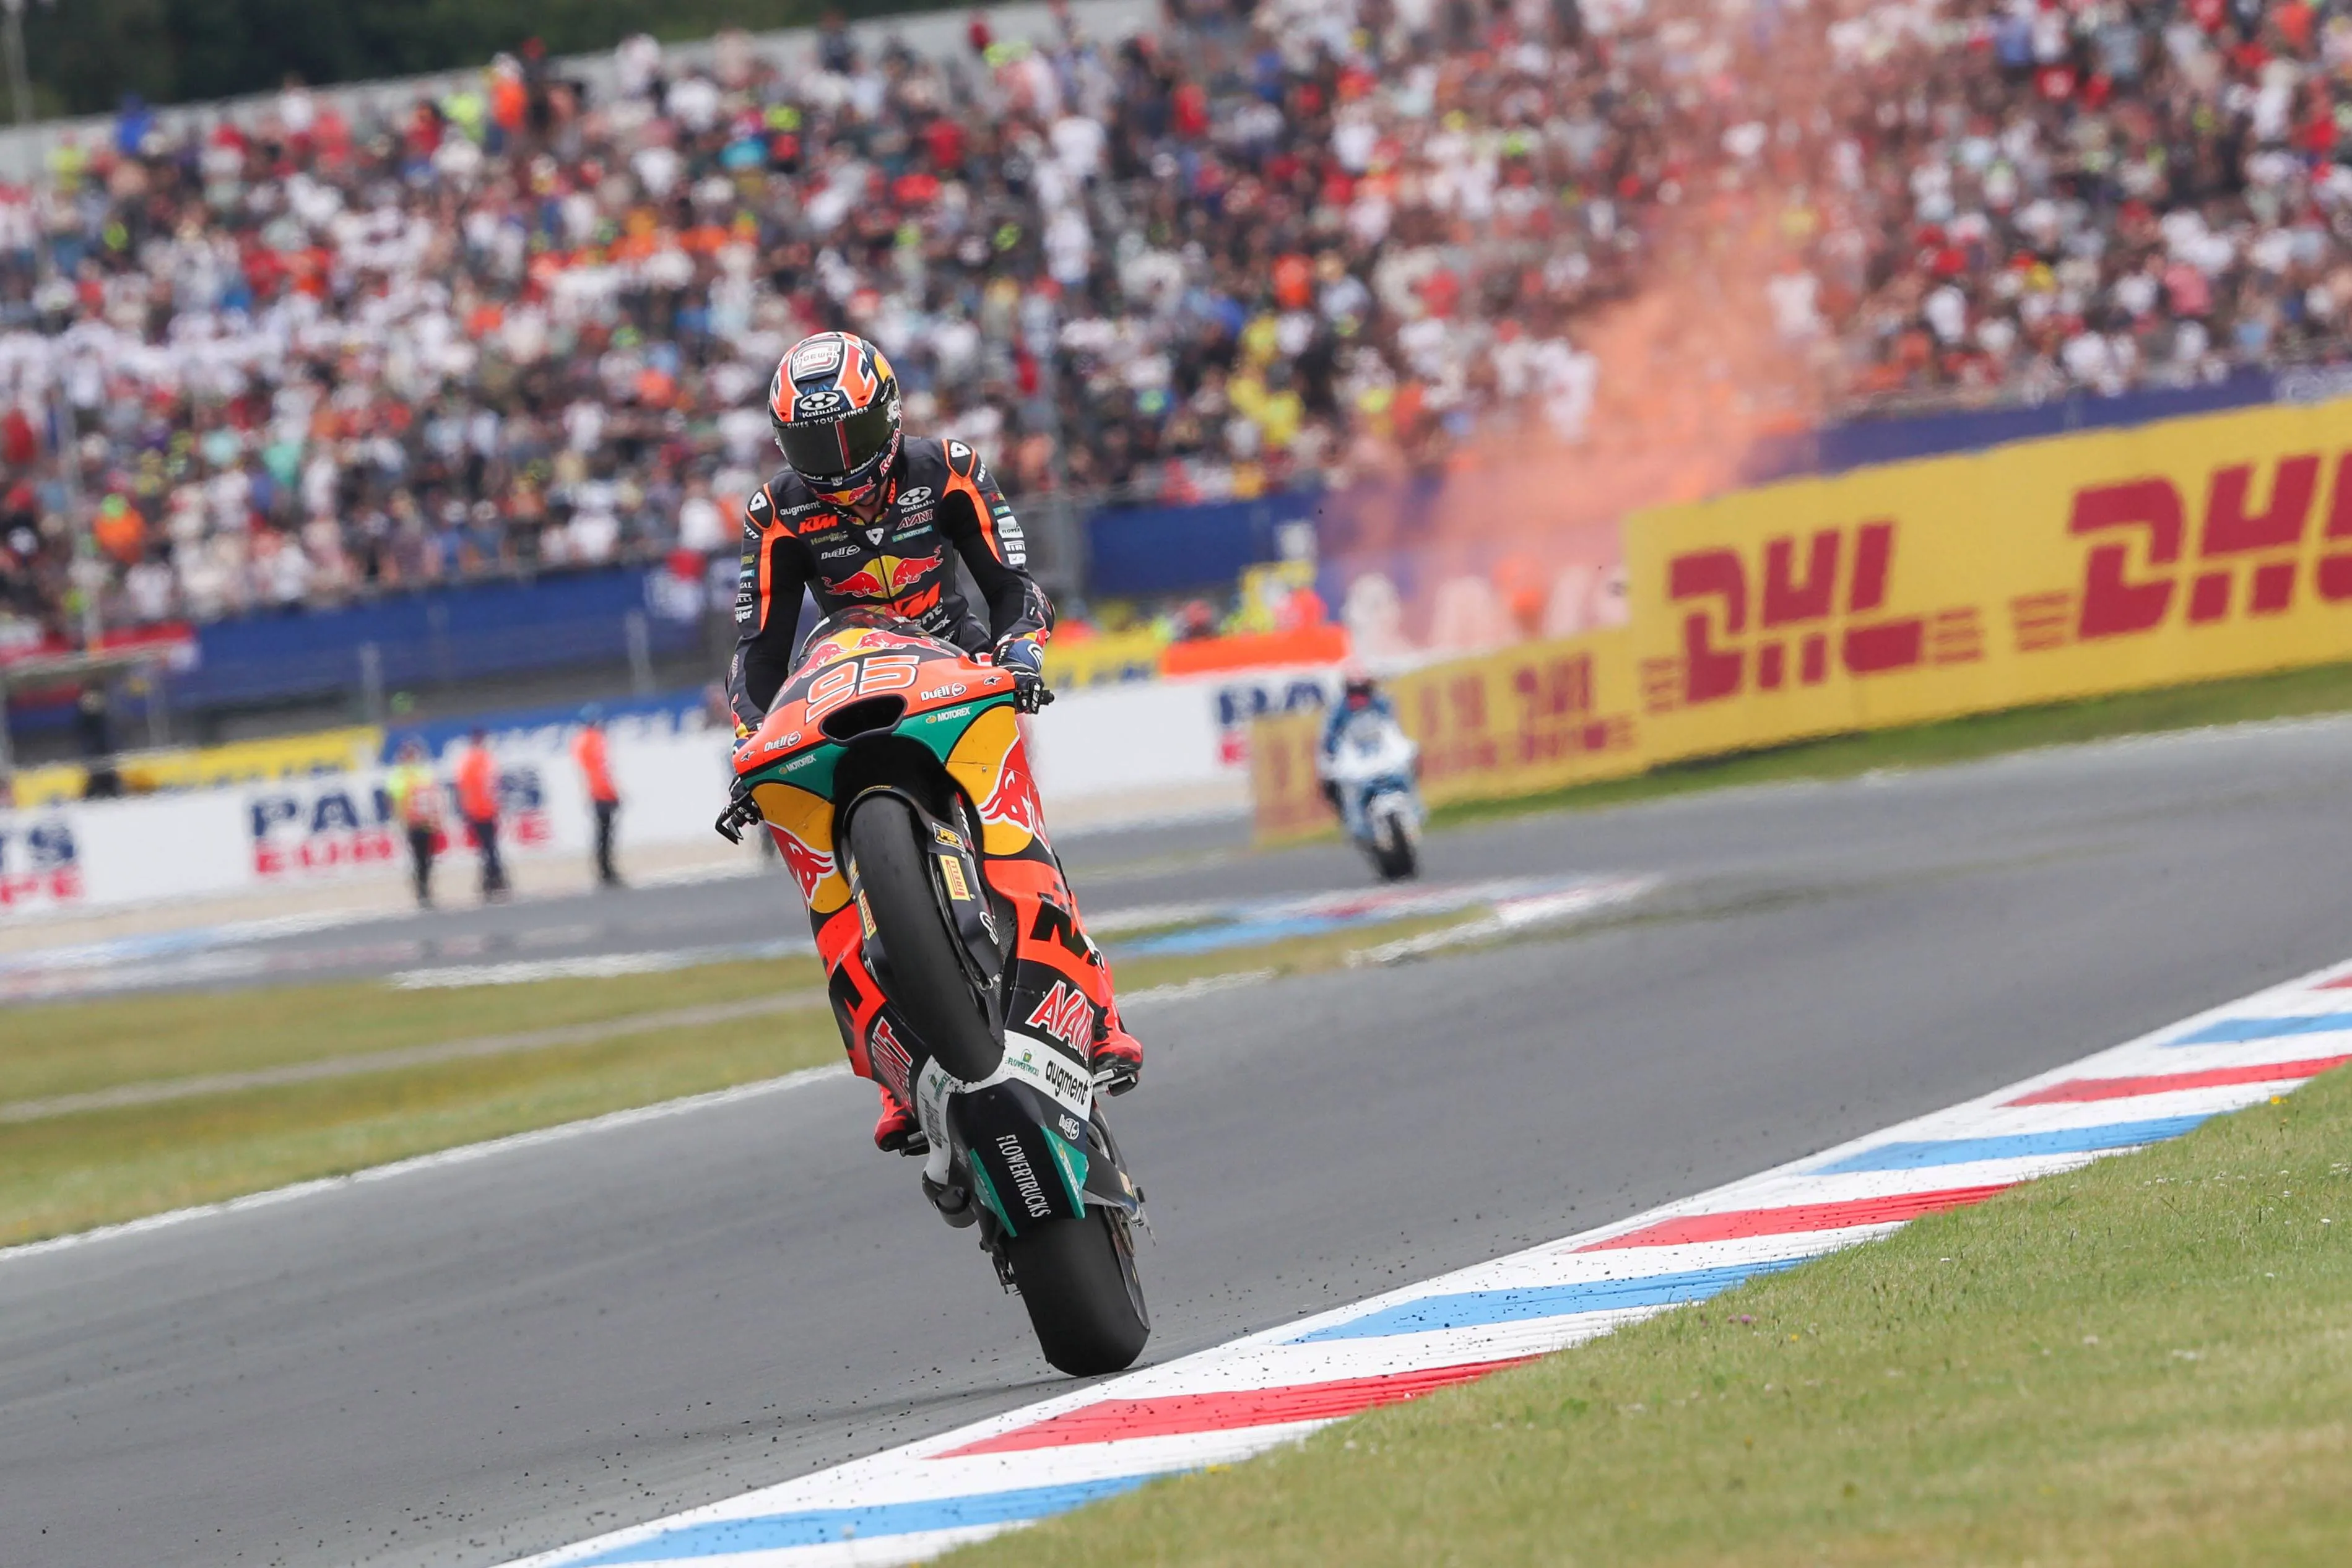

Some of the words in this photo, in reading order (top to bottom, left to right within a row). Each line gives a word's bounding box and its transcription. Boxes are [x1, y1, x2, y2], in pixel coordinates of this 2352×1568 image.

[814, 417, 833, 426] YOU
[837, 406, 869, 420] WINGS
[780, 500, 822, 516] augment
[901, 499, 935, 514] Kabuto
[799, 513, 838, 534] KTM
[896, 509, 934, 531] AVANT
[1669, 520, 1924, 706] DHL
[805, 654, 920, 724] 95
[937, 706, 971, 722] MOTOREX
[786, 753, 817, 773] MOTOREX
[945, 858, 966, 897] PIRELLI
[1045, 1059, 1089, 1107] augment
[996, 1134, 1051, 1218] FLOWERTRUCKS
